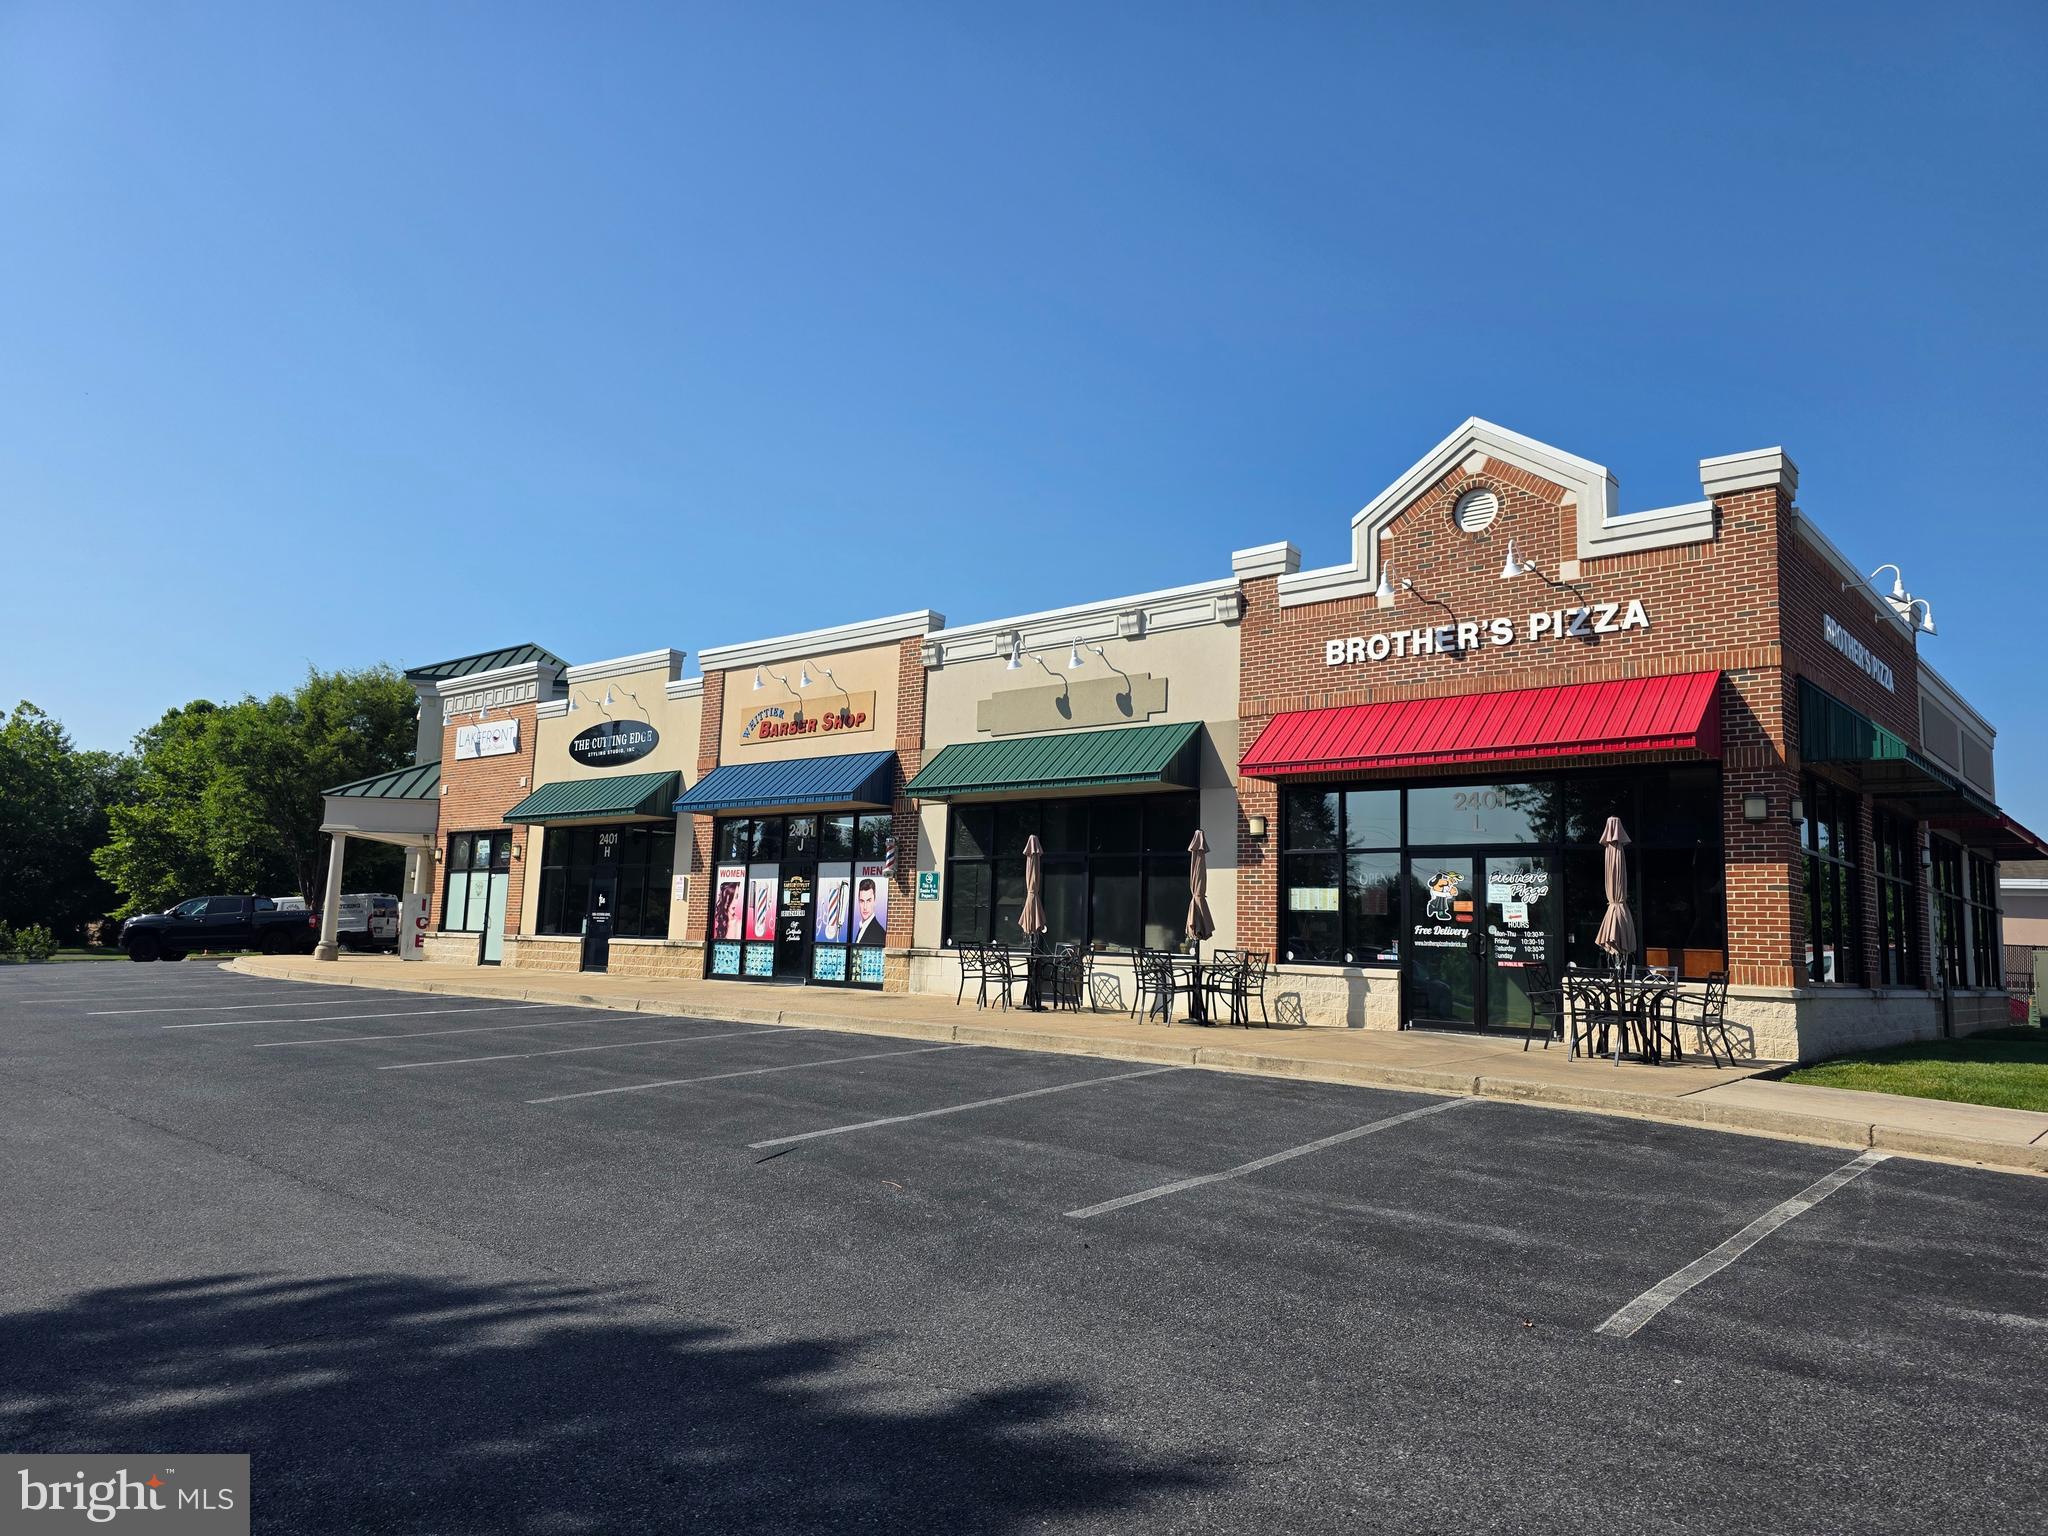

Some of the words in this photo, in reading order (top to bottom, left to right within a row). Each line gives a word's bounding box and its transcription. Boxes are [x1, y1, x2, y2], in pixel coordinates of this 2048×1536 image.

[1326, 618, 1515, 666] BROTHER'S
[1530, 599, 1650, 641] PIZZA
[1823, 613, 1871, 675] BROTHER'S
[1871, 655, 1895, 694] PIZZA
[742, 707, 785, 739] WHITTIER
[759, 719, 818, 739] BARBER
[821, 712, 867, 731] SHOP
[459, 726, 515, 748] LAKEFRONT
[574, 738, 590, 752] THE
[591, 733, 628, 750] CUTTING
[629, 730, 653, 744] EDGE
[1453, 791, 1508, 811] 2401
[789, 823, 814, 837] 2401
[599, 833, 618, 845] 2401
[797, 838, 804, 851] J
[604, 846, 611, 857] H
[720, 869, 746, 878] WOMEN
[862, 866, 883, 876] MEN
[415, 898, 429, 948] ICE
[1414, 925, 1432, 935] Free
[1433, 925, 1469, 938] Delivery
[1494, 945, 1517, 953] Saturday
[1494, 952, 1513, 960] Sunday
